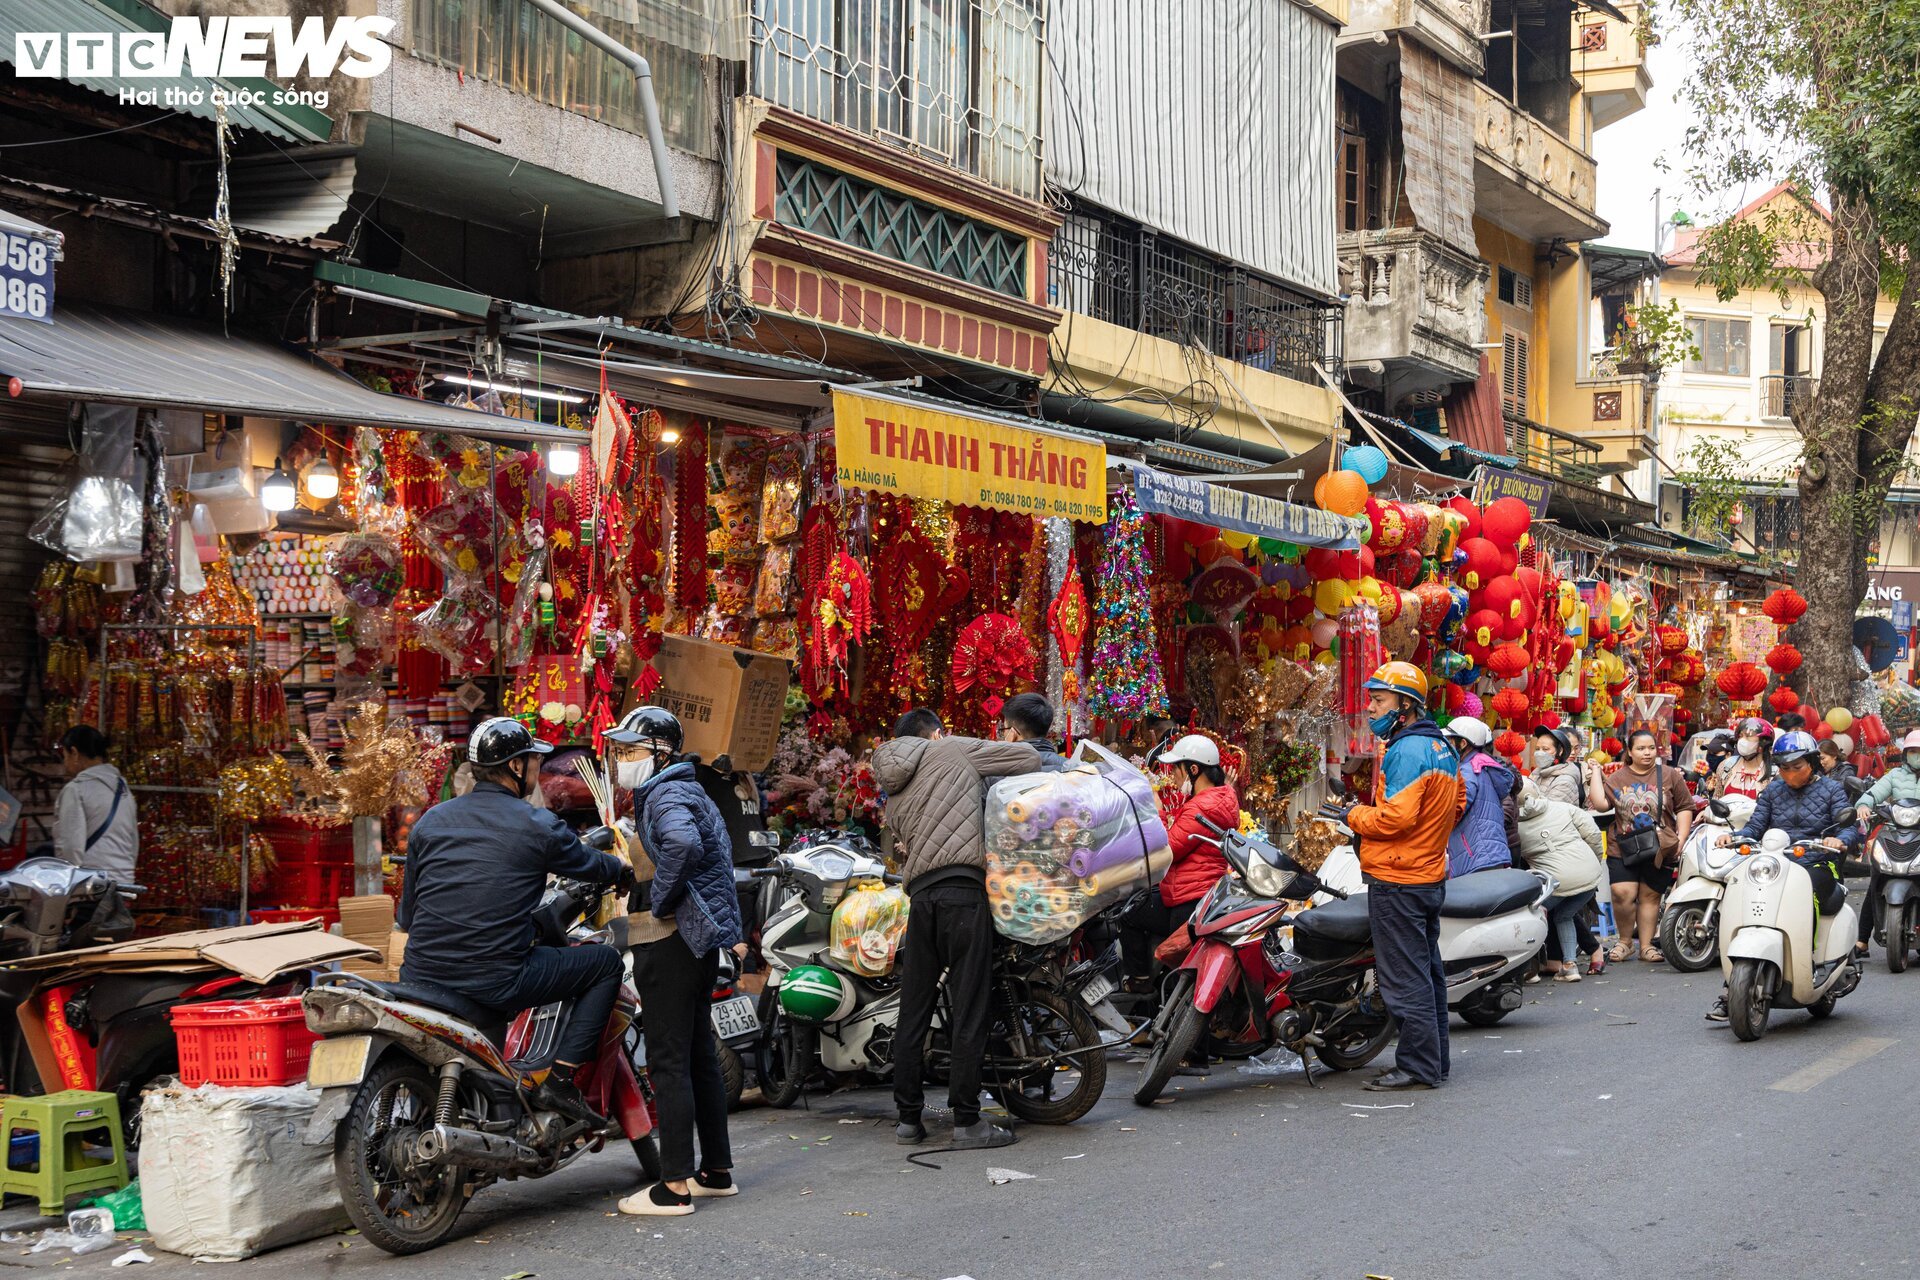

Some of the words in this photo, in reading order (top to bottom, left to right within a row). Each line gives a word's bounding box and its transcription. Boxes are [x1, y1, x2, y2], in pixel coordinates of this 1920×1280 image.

[865, 418, 979, 472] THANH
[989, 438, 1087, 490] THẮNG
[839, 467, 850, 480] 2A
[854, 467, 881, 485] HÀNG
[883, 473, 897, 488] MÃ
[1190, 480, 1204, 496] 424
[980, 488, 993, 502] ĐT:
[995, 491, 1015, 506] 0984
[1017, 494, 1031, 508] 780
[1054, 500, 1067, 512] 084
[1069, 502, 1082, 515] 820
[1085, 504, 1103, 517] 1995
[716, 1001, 747, 1020] 29-01
[719, 1014, 756, 1036] 521.58
